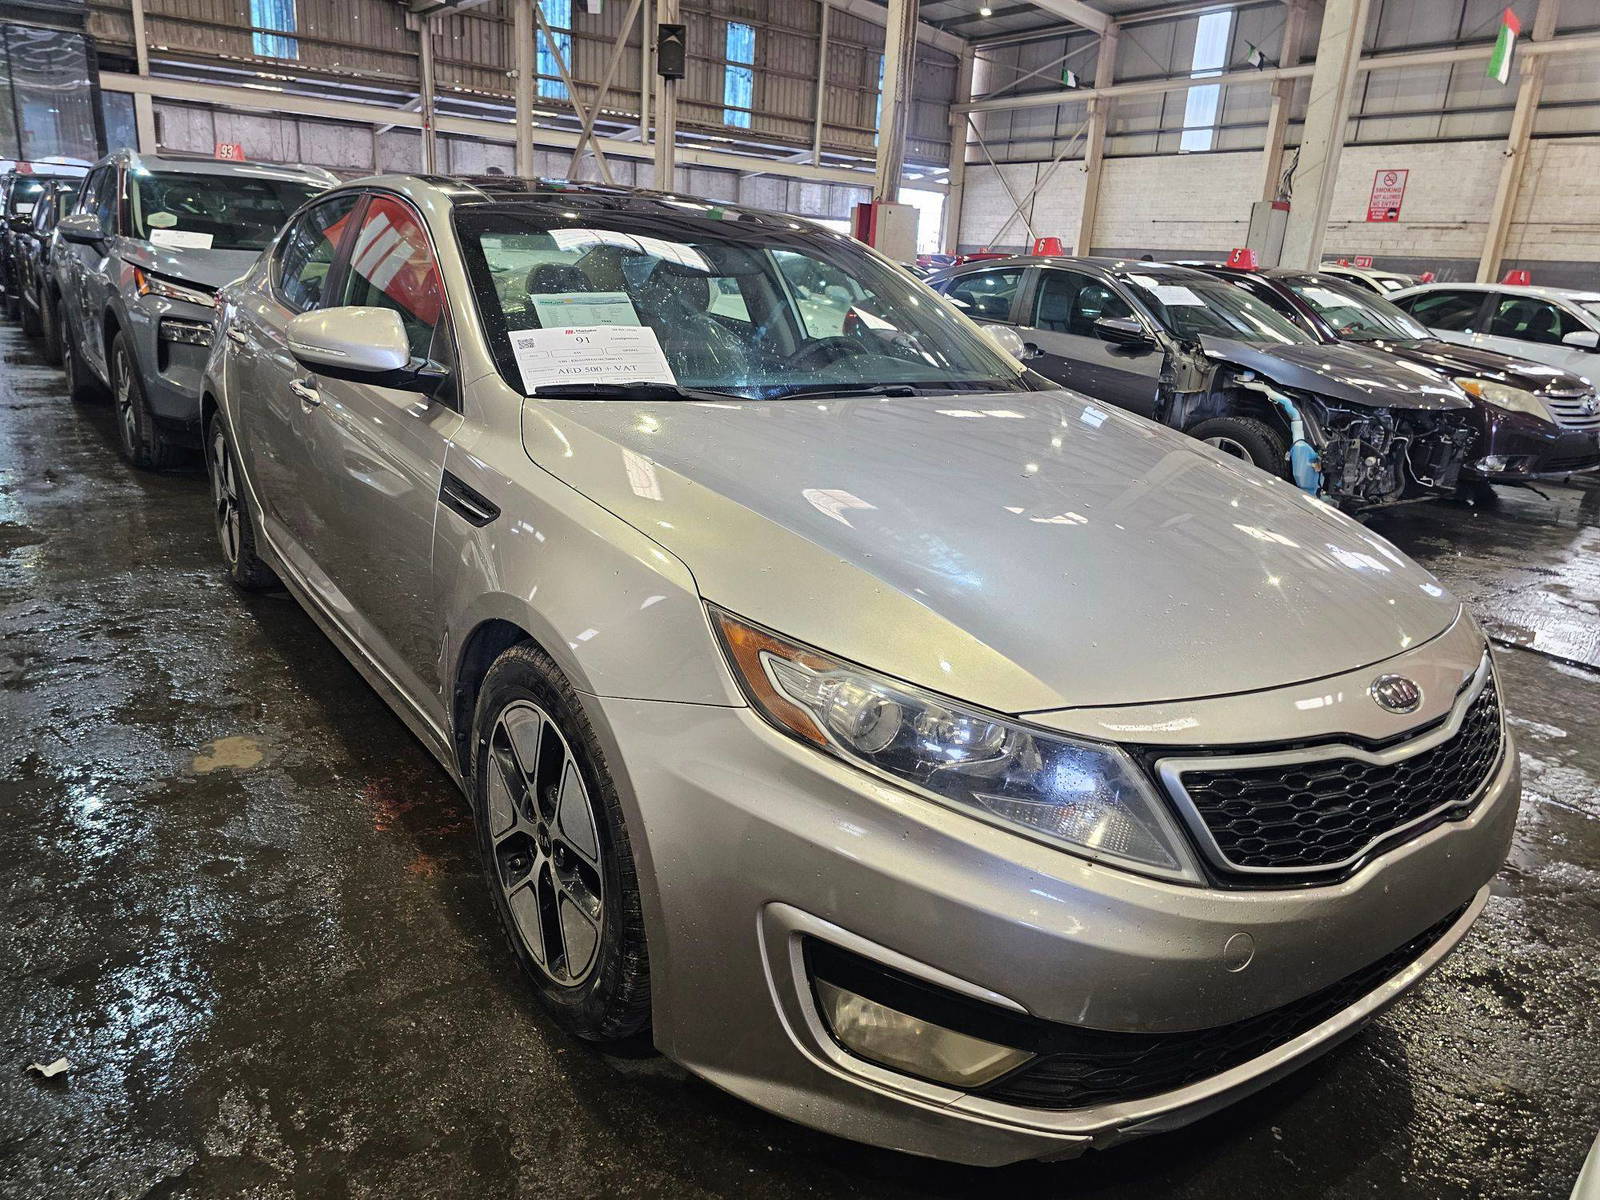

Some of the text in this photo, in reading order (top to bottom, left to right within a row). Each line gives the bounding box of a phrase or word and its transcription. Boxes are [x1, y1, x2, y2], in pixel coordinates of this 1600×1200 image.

[220, 144, 233, 158] 93
[1038, 238, 1046, 252] 6
[1233, 249, 1242, 263] 5
[575, 336, 591, 344] 91
[558, 367, 582, 375] AED
[1380, 680, 1418, 706] KIA
